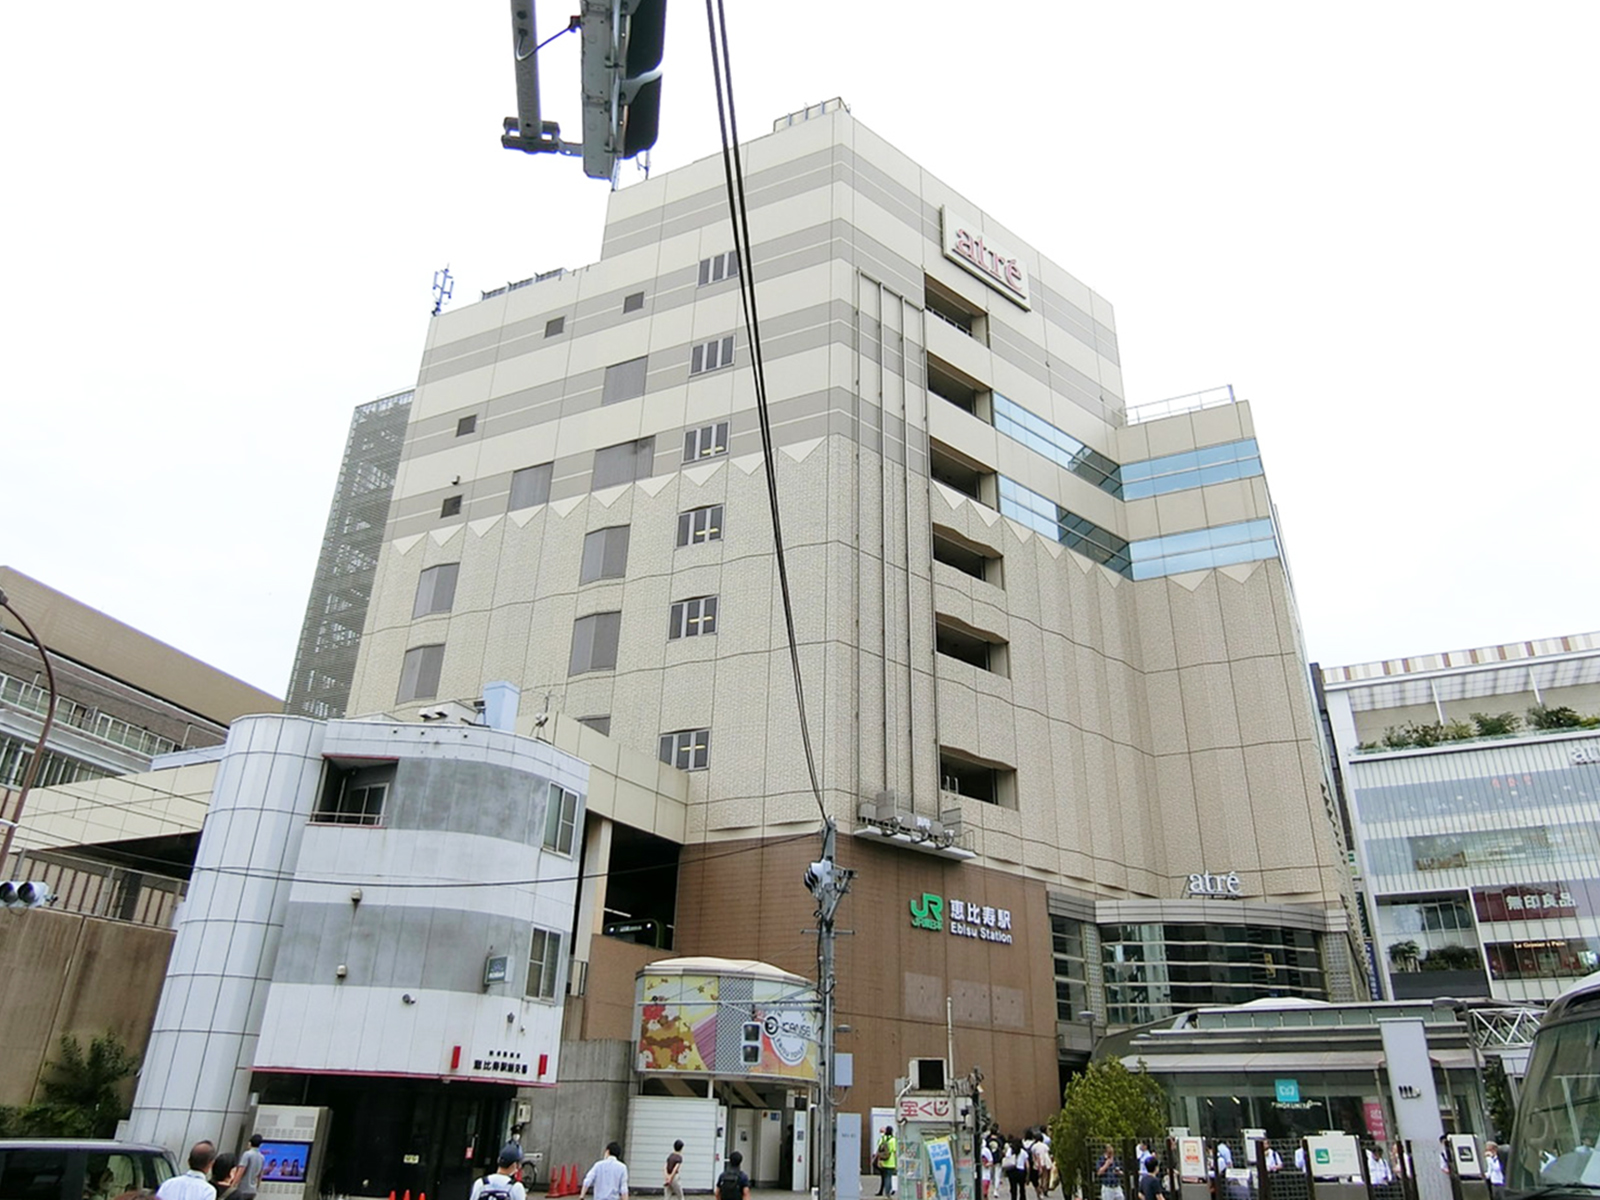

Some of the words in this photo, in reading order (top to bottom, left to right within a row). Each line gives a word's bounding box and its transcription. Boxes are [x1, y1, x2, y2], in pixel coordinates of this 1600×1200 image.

[956, 228, 1023, 291] atré
[1188, 869, 1241, 893] atré
[910, 892, 943, 921] JR
[1506, 892, 1576, 911] 無印良品
[949, 899, 1012, 930] 恵比寿駅
[950, 921, 978, 938] Ebisu
[979, 926, 1013, 944] Station
[900, 1101, 949, 1117] 宝くじ
[934, 1158, 952, 1185] 7
